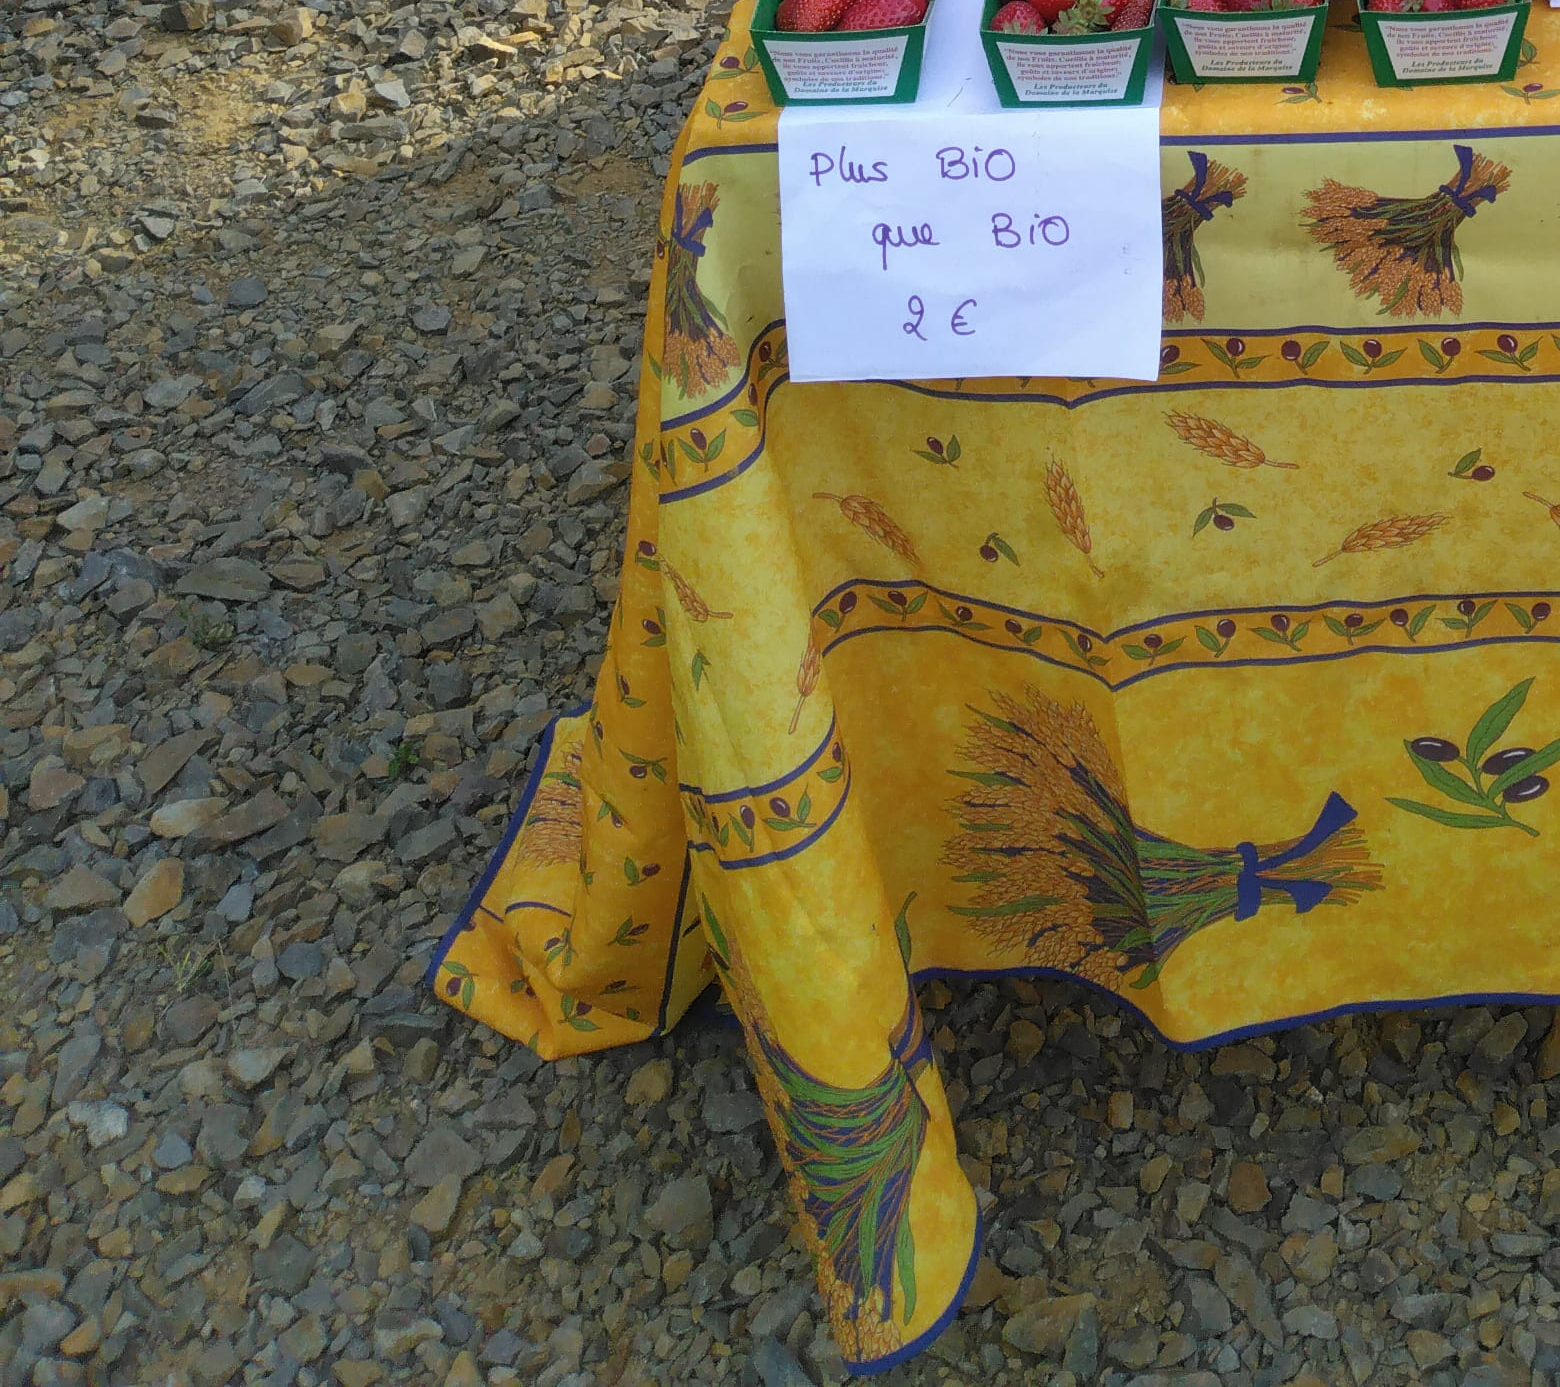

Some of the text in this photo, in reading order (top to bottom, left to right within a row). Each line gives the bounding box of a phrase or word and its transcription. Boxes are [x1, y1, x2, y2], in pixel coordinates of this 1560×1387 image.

[809, 146, 888, 186] Plus
[872, 222, 940, 270] que
[903, 294, 978, 341] 2 €
